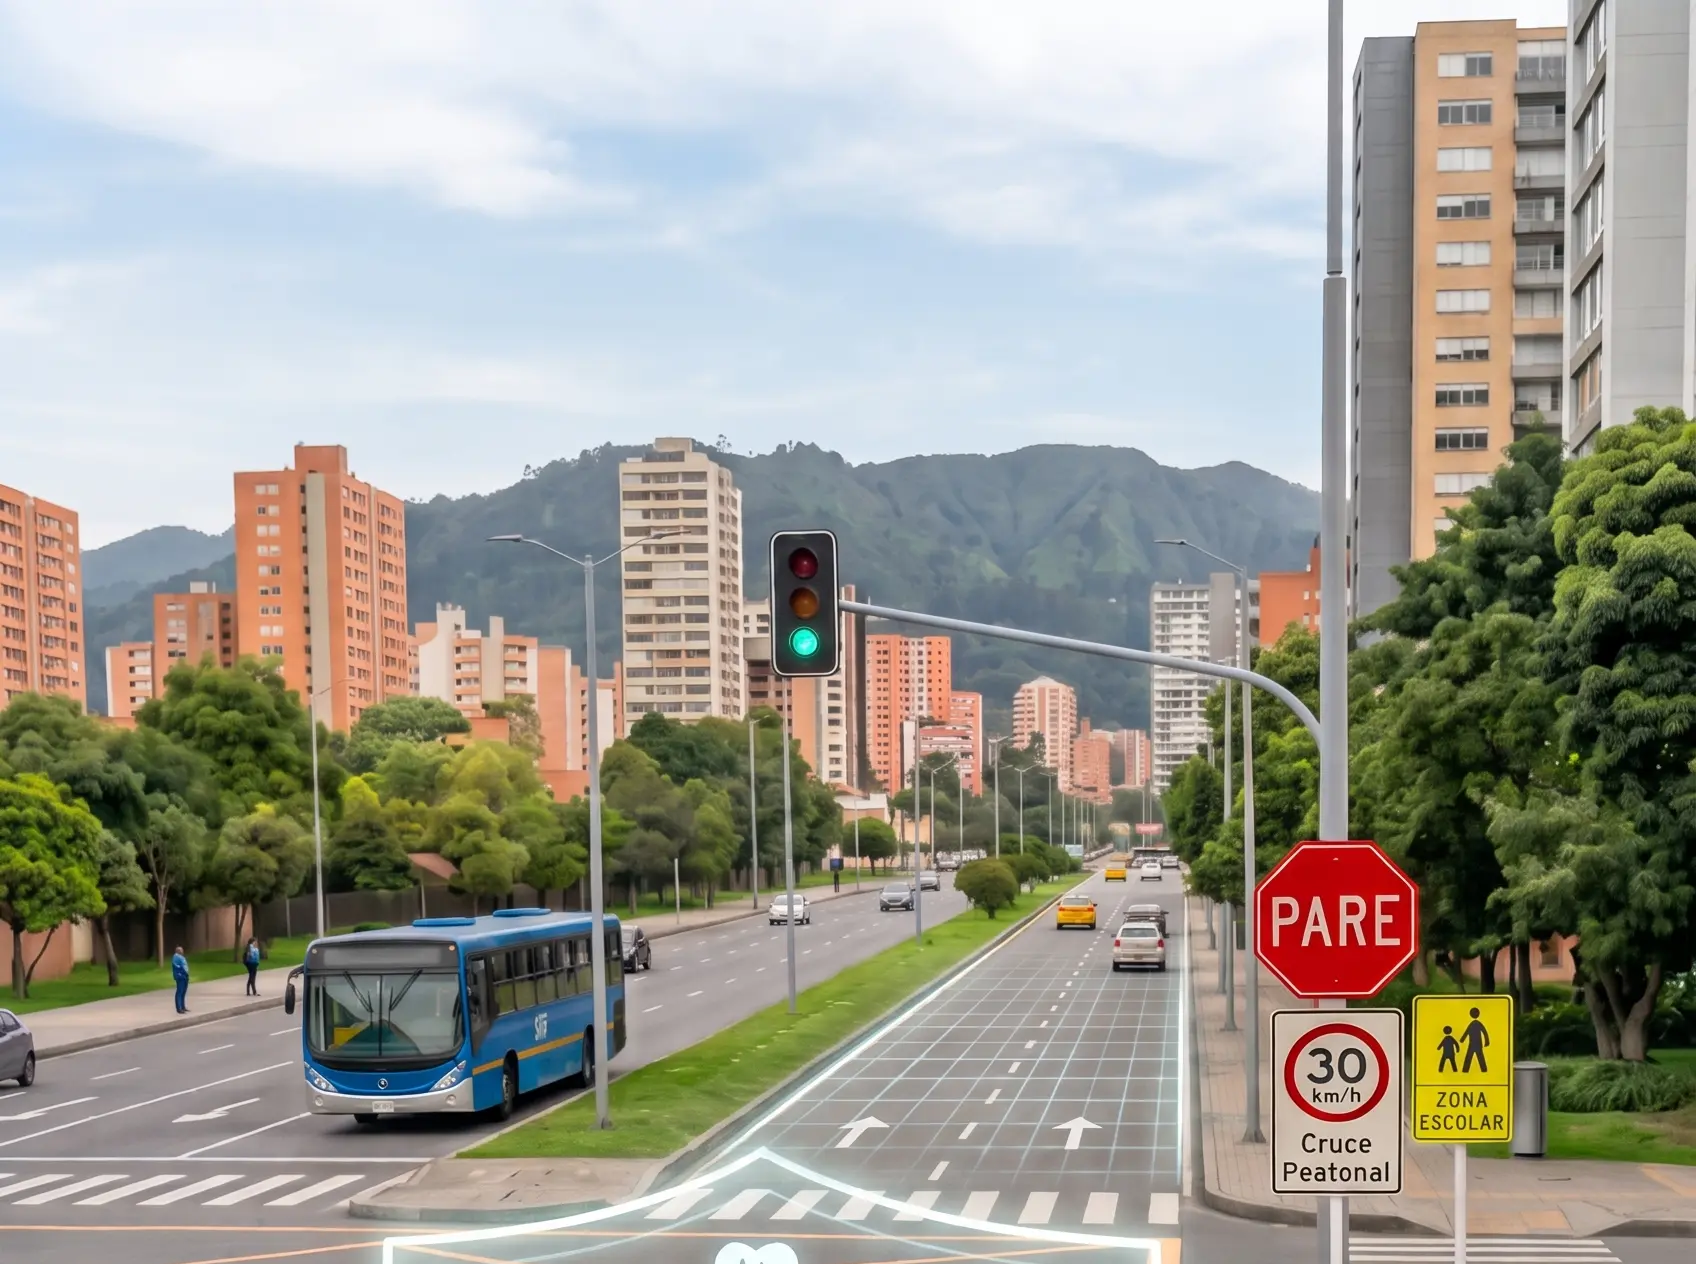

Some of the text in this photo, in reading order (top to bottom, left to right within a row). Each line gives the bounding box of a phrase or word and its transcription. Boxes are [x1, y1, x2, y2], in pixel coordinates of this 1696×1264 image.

[1272, 895, 1400, 947] PARE
[1307, 1048, 1367, 1084] 30
[1312, 1087, 1361, 1104] km/h
[1436, 1091, 1488, 1108] ZONA
[1420, 1115, 1504, 1131] ESCOLAR
[1301, 1133, 1372, 1154] Cruce
[1283, 1161, 1390, 1183] Peatonal
